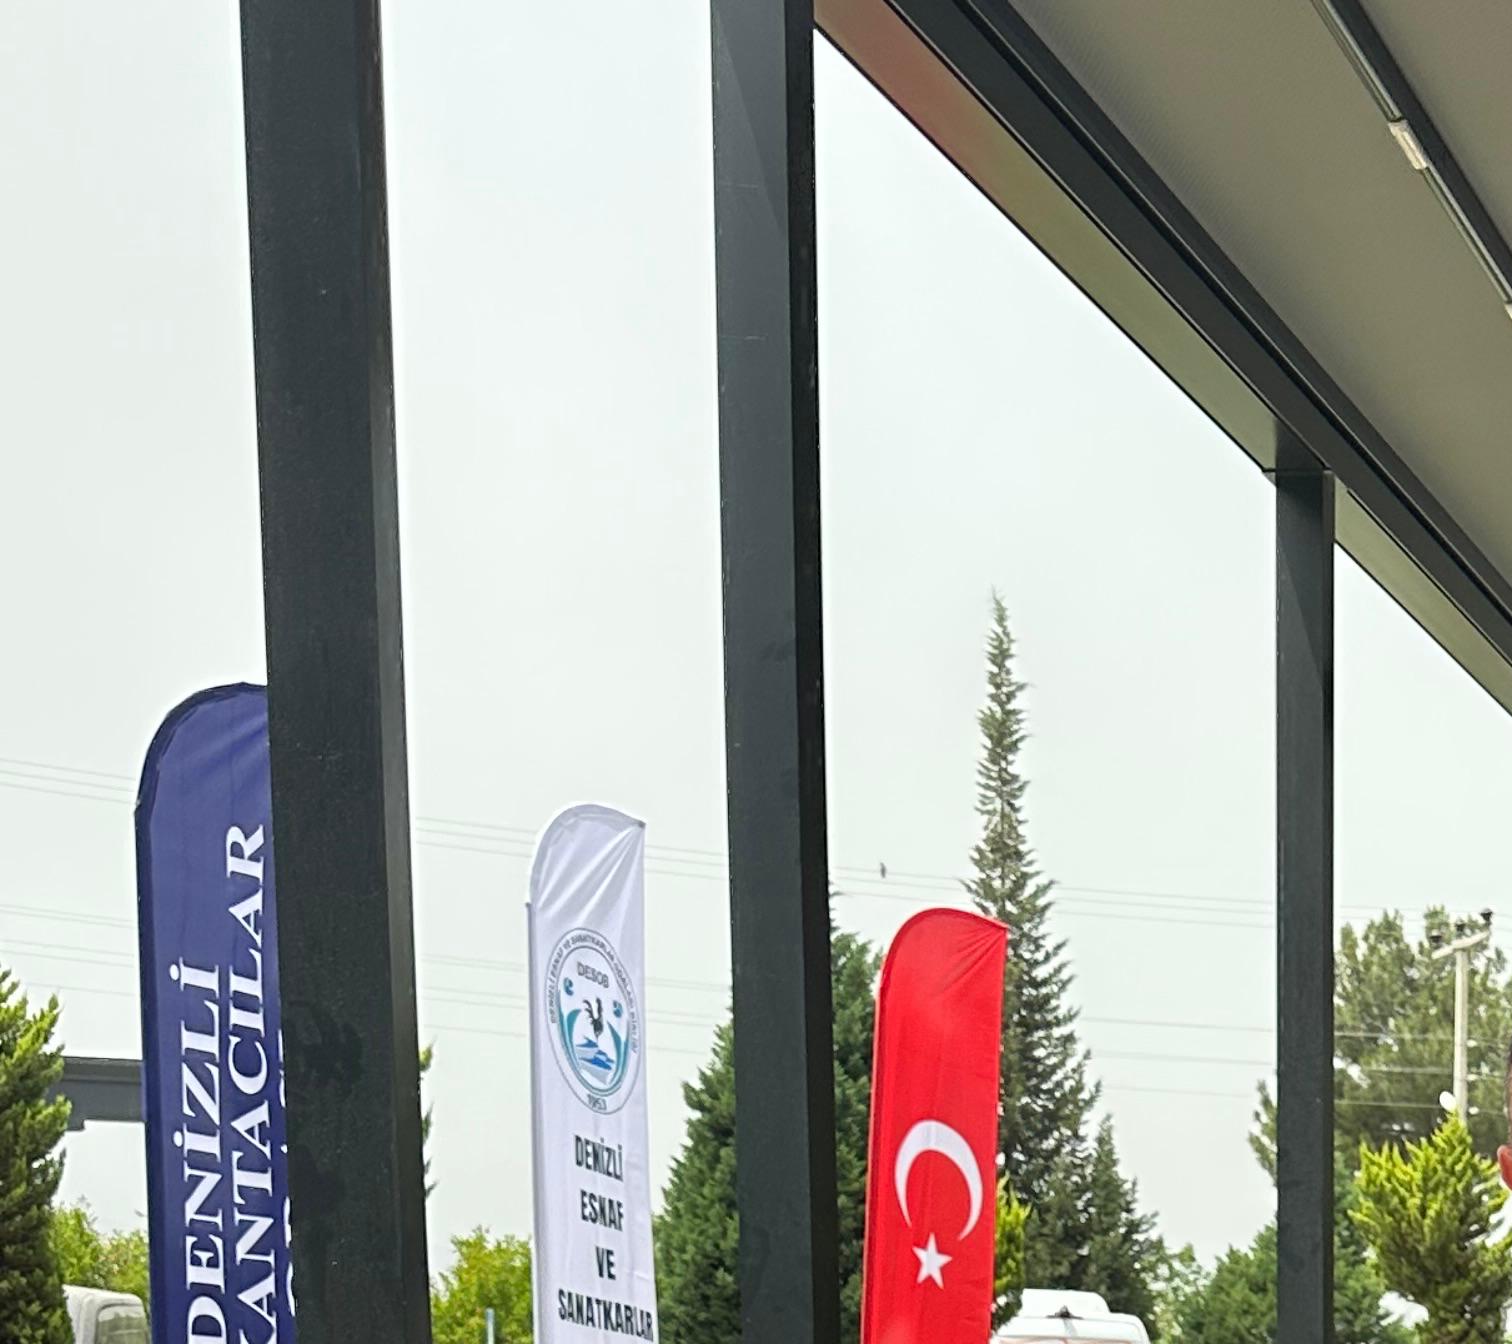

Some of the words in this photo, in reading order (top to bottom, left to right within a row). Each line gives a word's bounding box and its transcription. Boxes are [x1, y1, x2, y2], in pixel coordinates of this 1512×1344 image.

[574, 1134, 623, 1182] DENİZLİ
[580, 1189, 624, 1232] ESNAF
[595, 1246, 616, 1280] VE
[558, 1288, 654, 1342] SANATKARLAR
